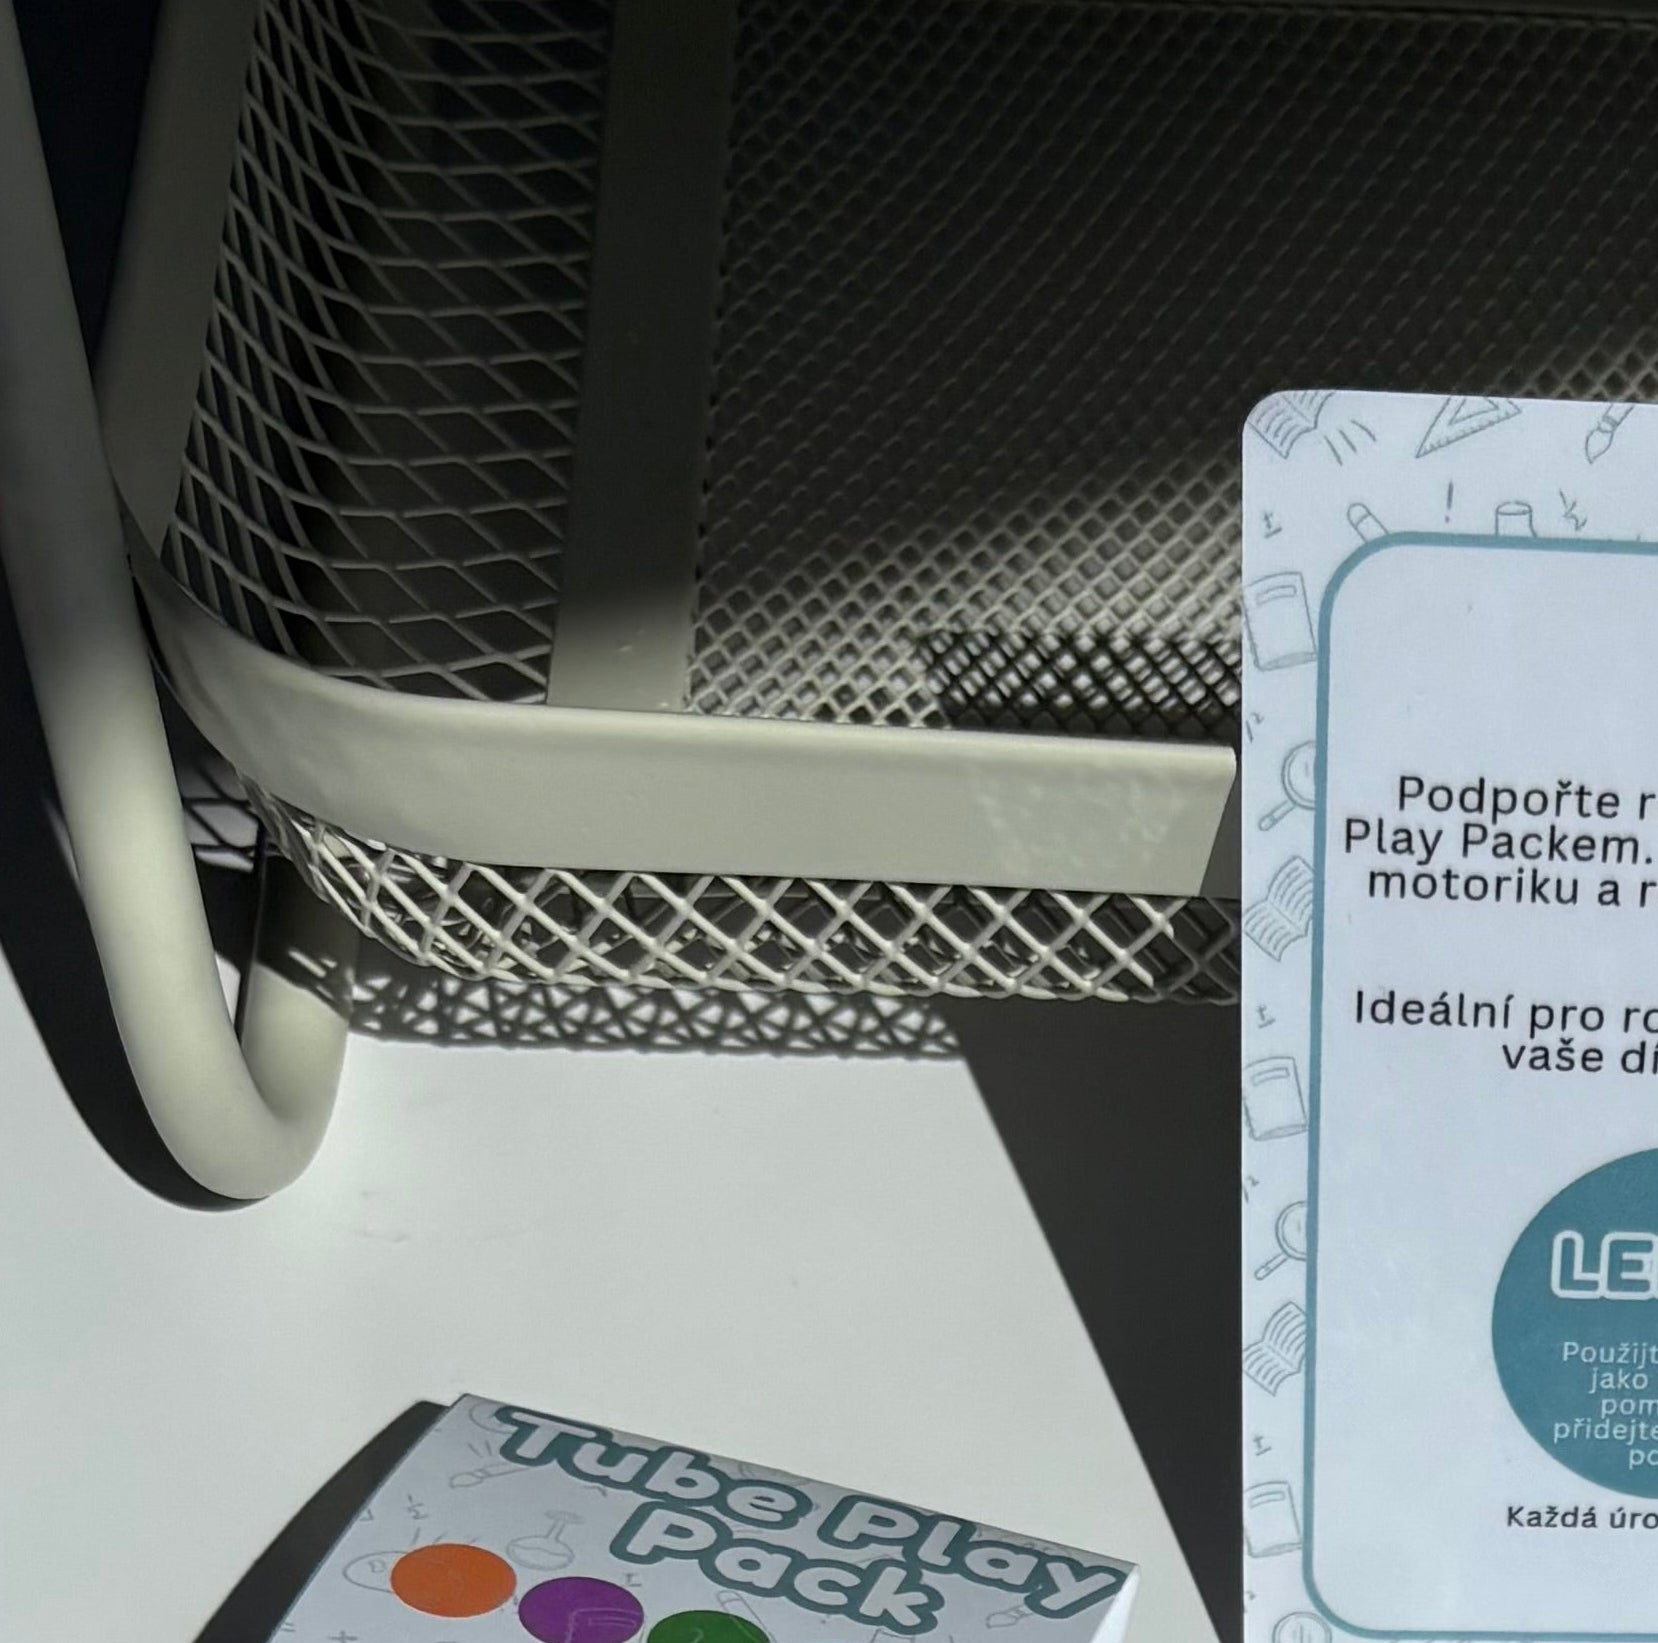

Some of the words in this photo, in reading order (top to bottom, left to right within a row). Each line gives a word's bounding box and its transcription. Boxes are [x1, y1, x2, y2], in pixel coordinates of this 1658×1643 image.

[1399, 776, 1620, 824] Podpořte
[1345, 818, 1442, 865] Play
[1462, 823, 1654, 864] Packem.
[1369, 868, 1577, 905] motoriku
[1598, 880, 1620, 907] a
[1355, 991, 1514, 1030] Ideální
[1530, 1002, 1603, 1038] pro
[1503, 1041, 1603, 1073] vaše
[1589, 1369, 1648, 1394] jako
[494, 1407, 813, 1531] Tube
[818, 1495, 1130, 1621] Play
[1506, 1506, 1598, 1529] Každá
[609, 1499, 945, 1636] Pack
